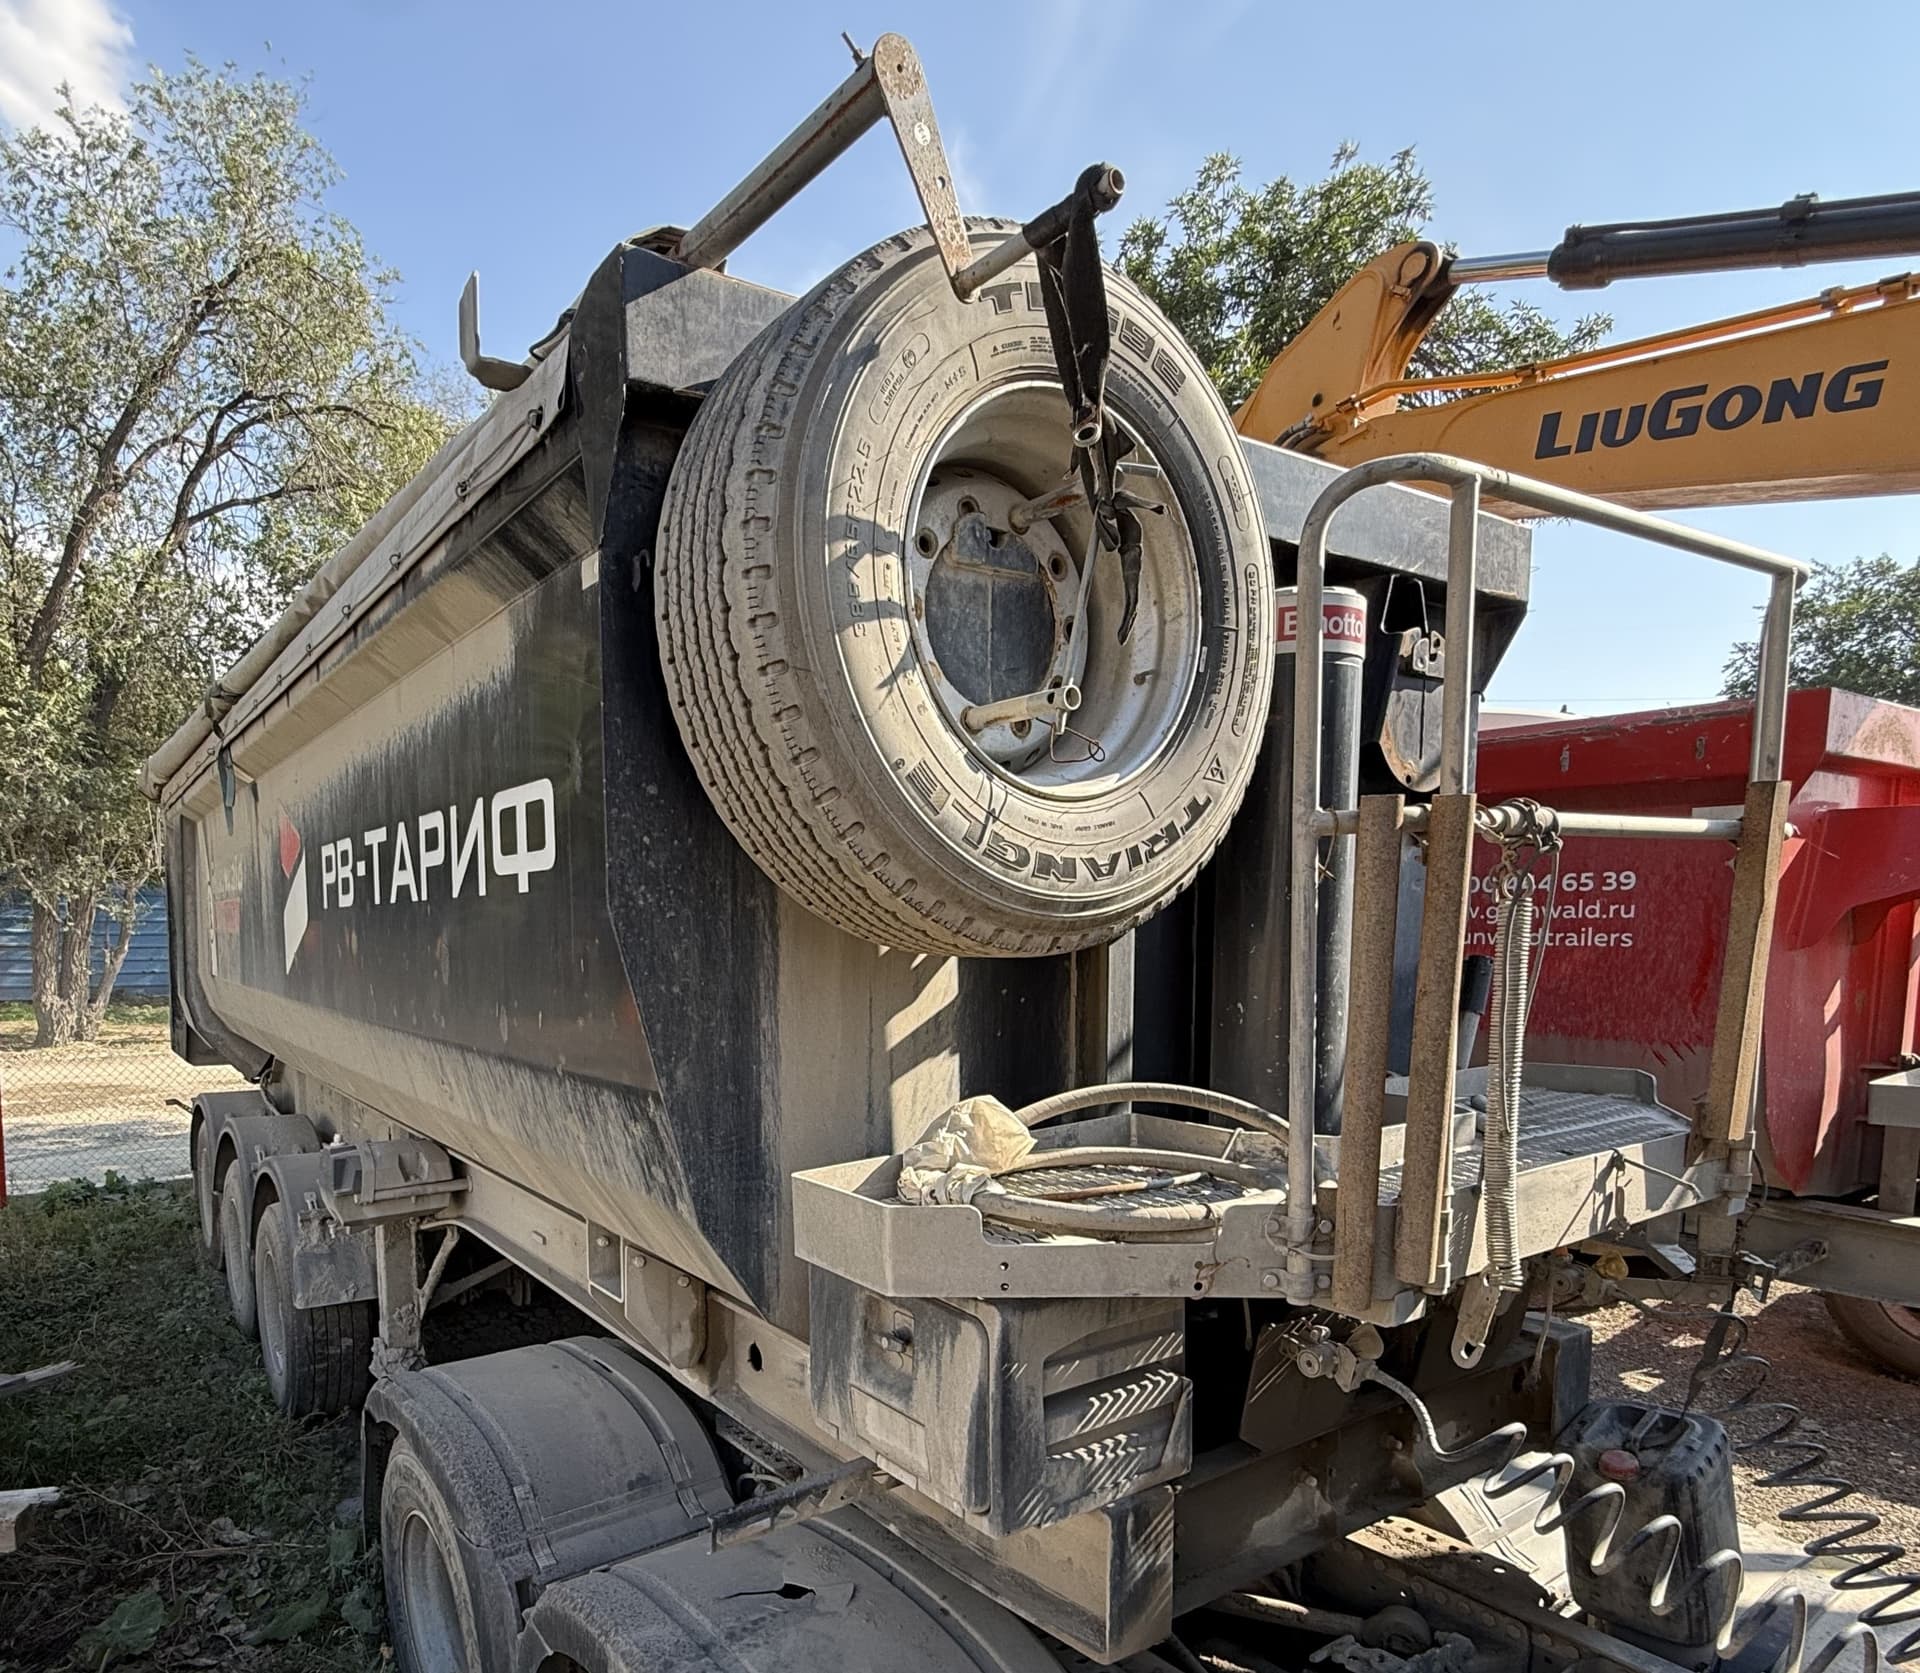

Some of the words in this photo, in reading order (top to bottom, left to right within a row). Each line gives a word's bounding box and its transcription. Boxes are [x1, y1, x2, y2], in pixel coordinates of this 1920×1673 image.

[321, 778, 556, 910] РВ-ТАРИФ
[905, 757, 1213, 883] TRIANGLE
[1561, 872, 1595, 892] 65
[1601, 870, 1637, 892] 39
